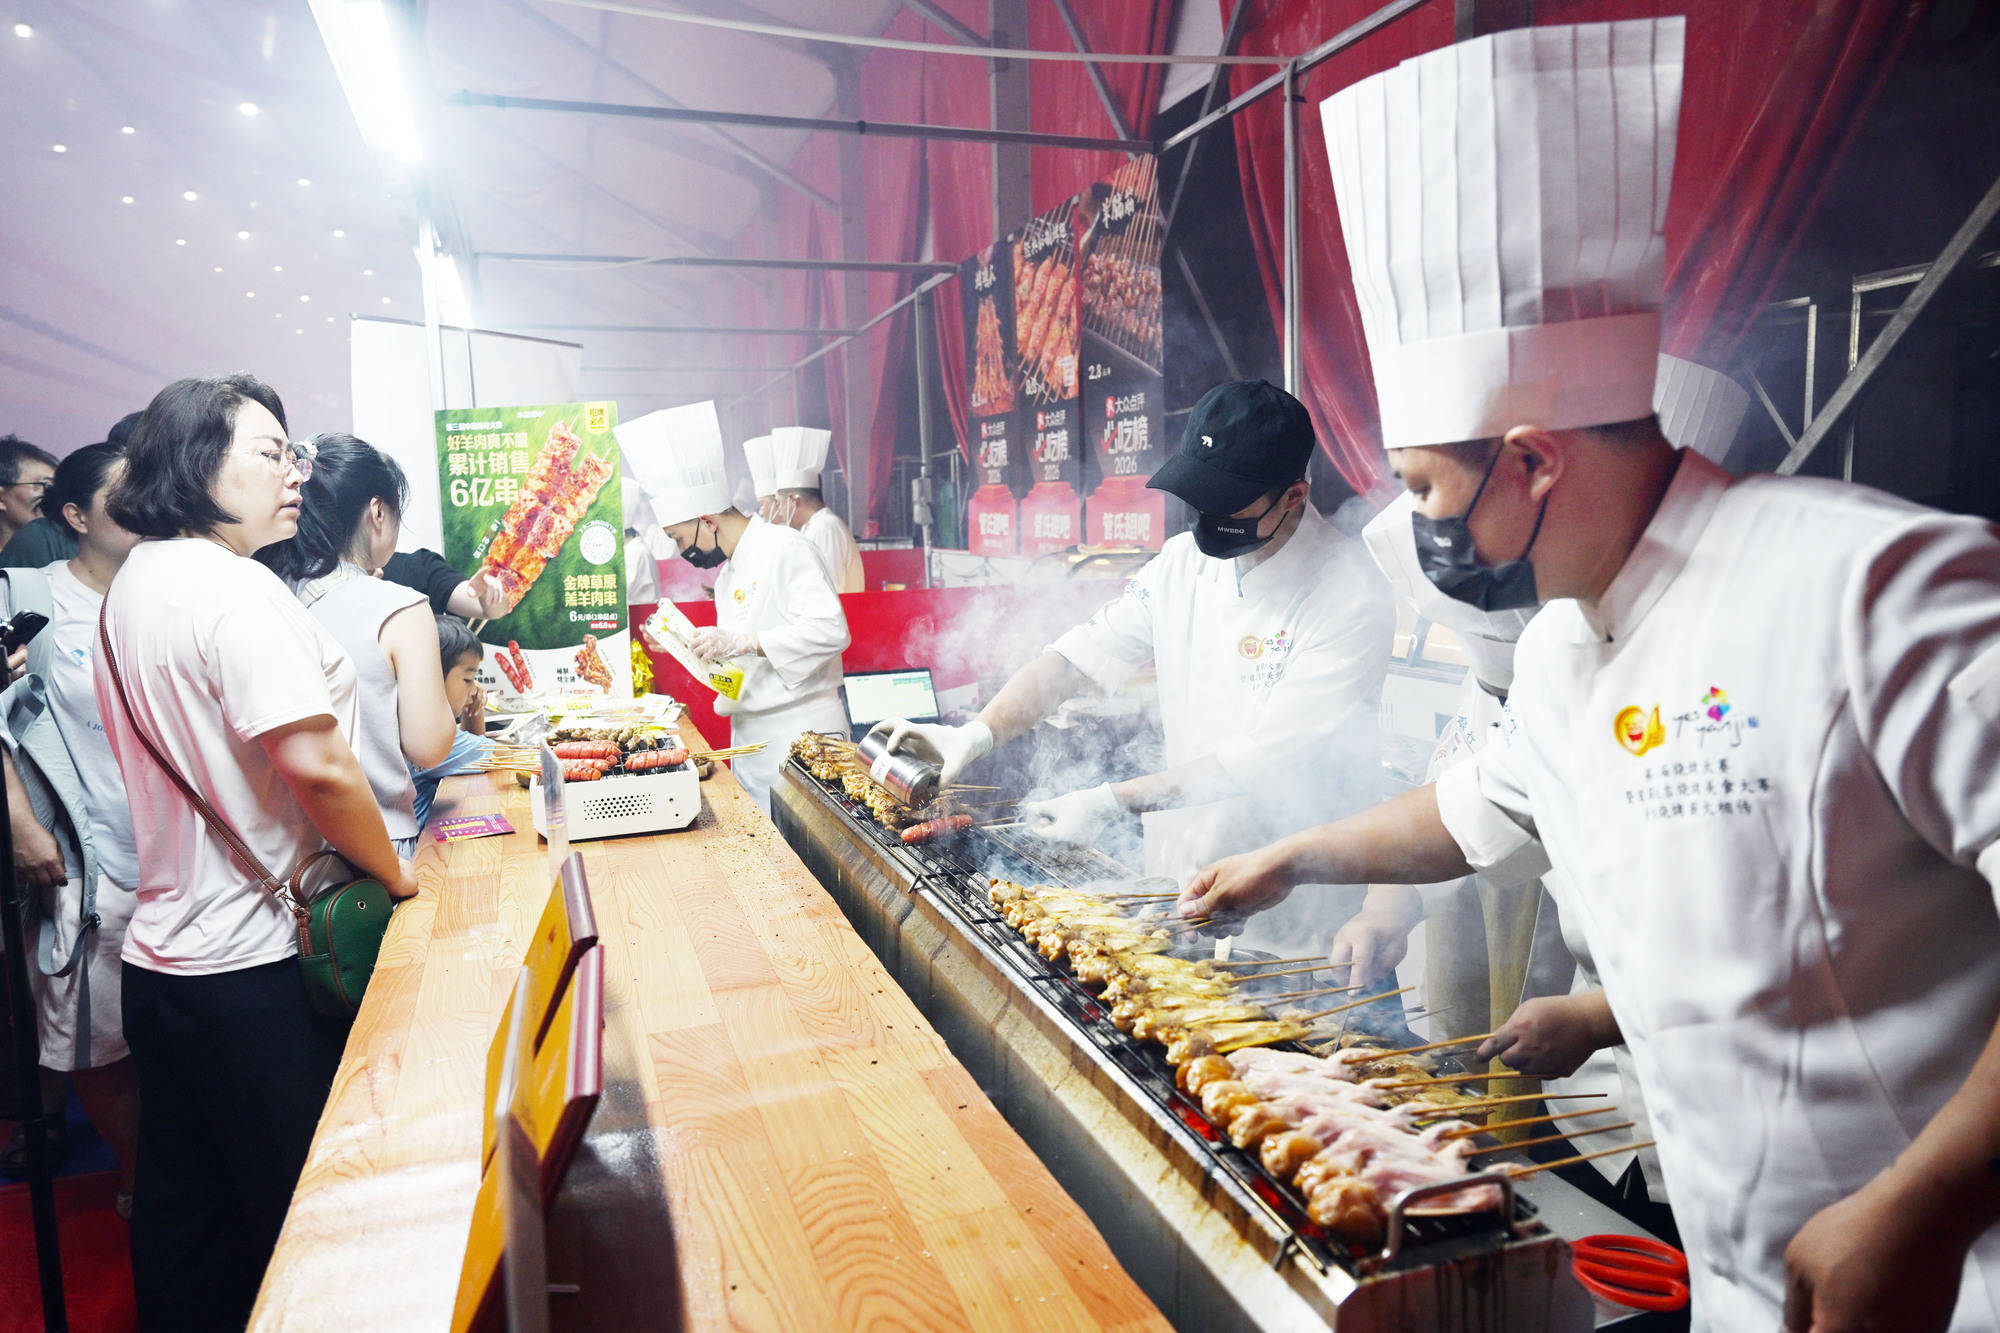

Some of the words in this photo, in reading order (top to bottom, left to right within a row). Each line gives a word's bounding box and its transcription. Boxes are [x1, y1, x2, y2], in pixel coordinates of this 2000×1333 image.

[1115, 392, 1145, 414] 大众点评
[1045, 409, 1066, 427] 大众点评
[1102, 414, 1149, 455] 必吃榜
[449, 450, 529, 476] 累计销售
[1114, 455, 1138, 474] 2026
[450, 476, 519, 507] 6亿串
[563, 574, 617, 591] 金牌草原
[564, 591, 617, 607] 羔羊肉串
